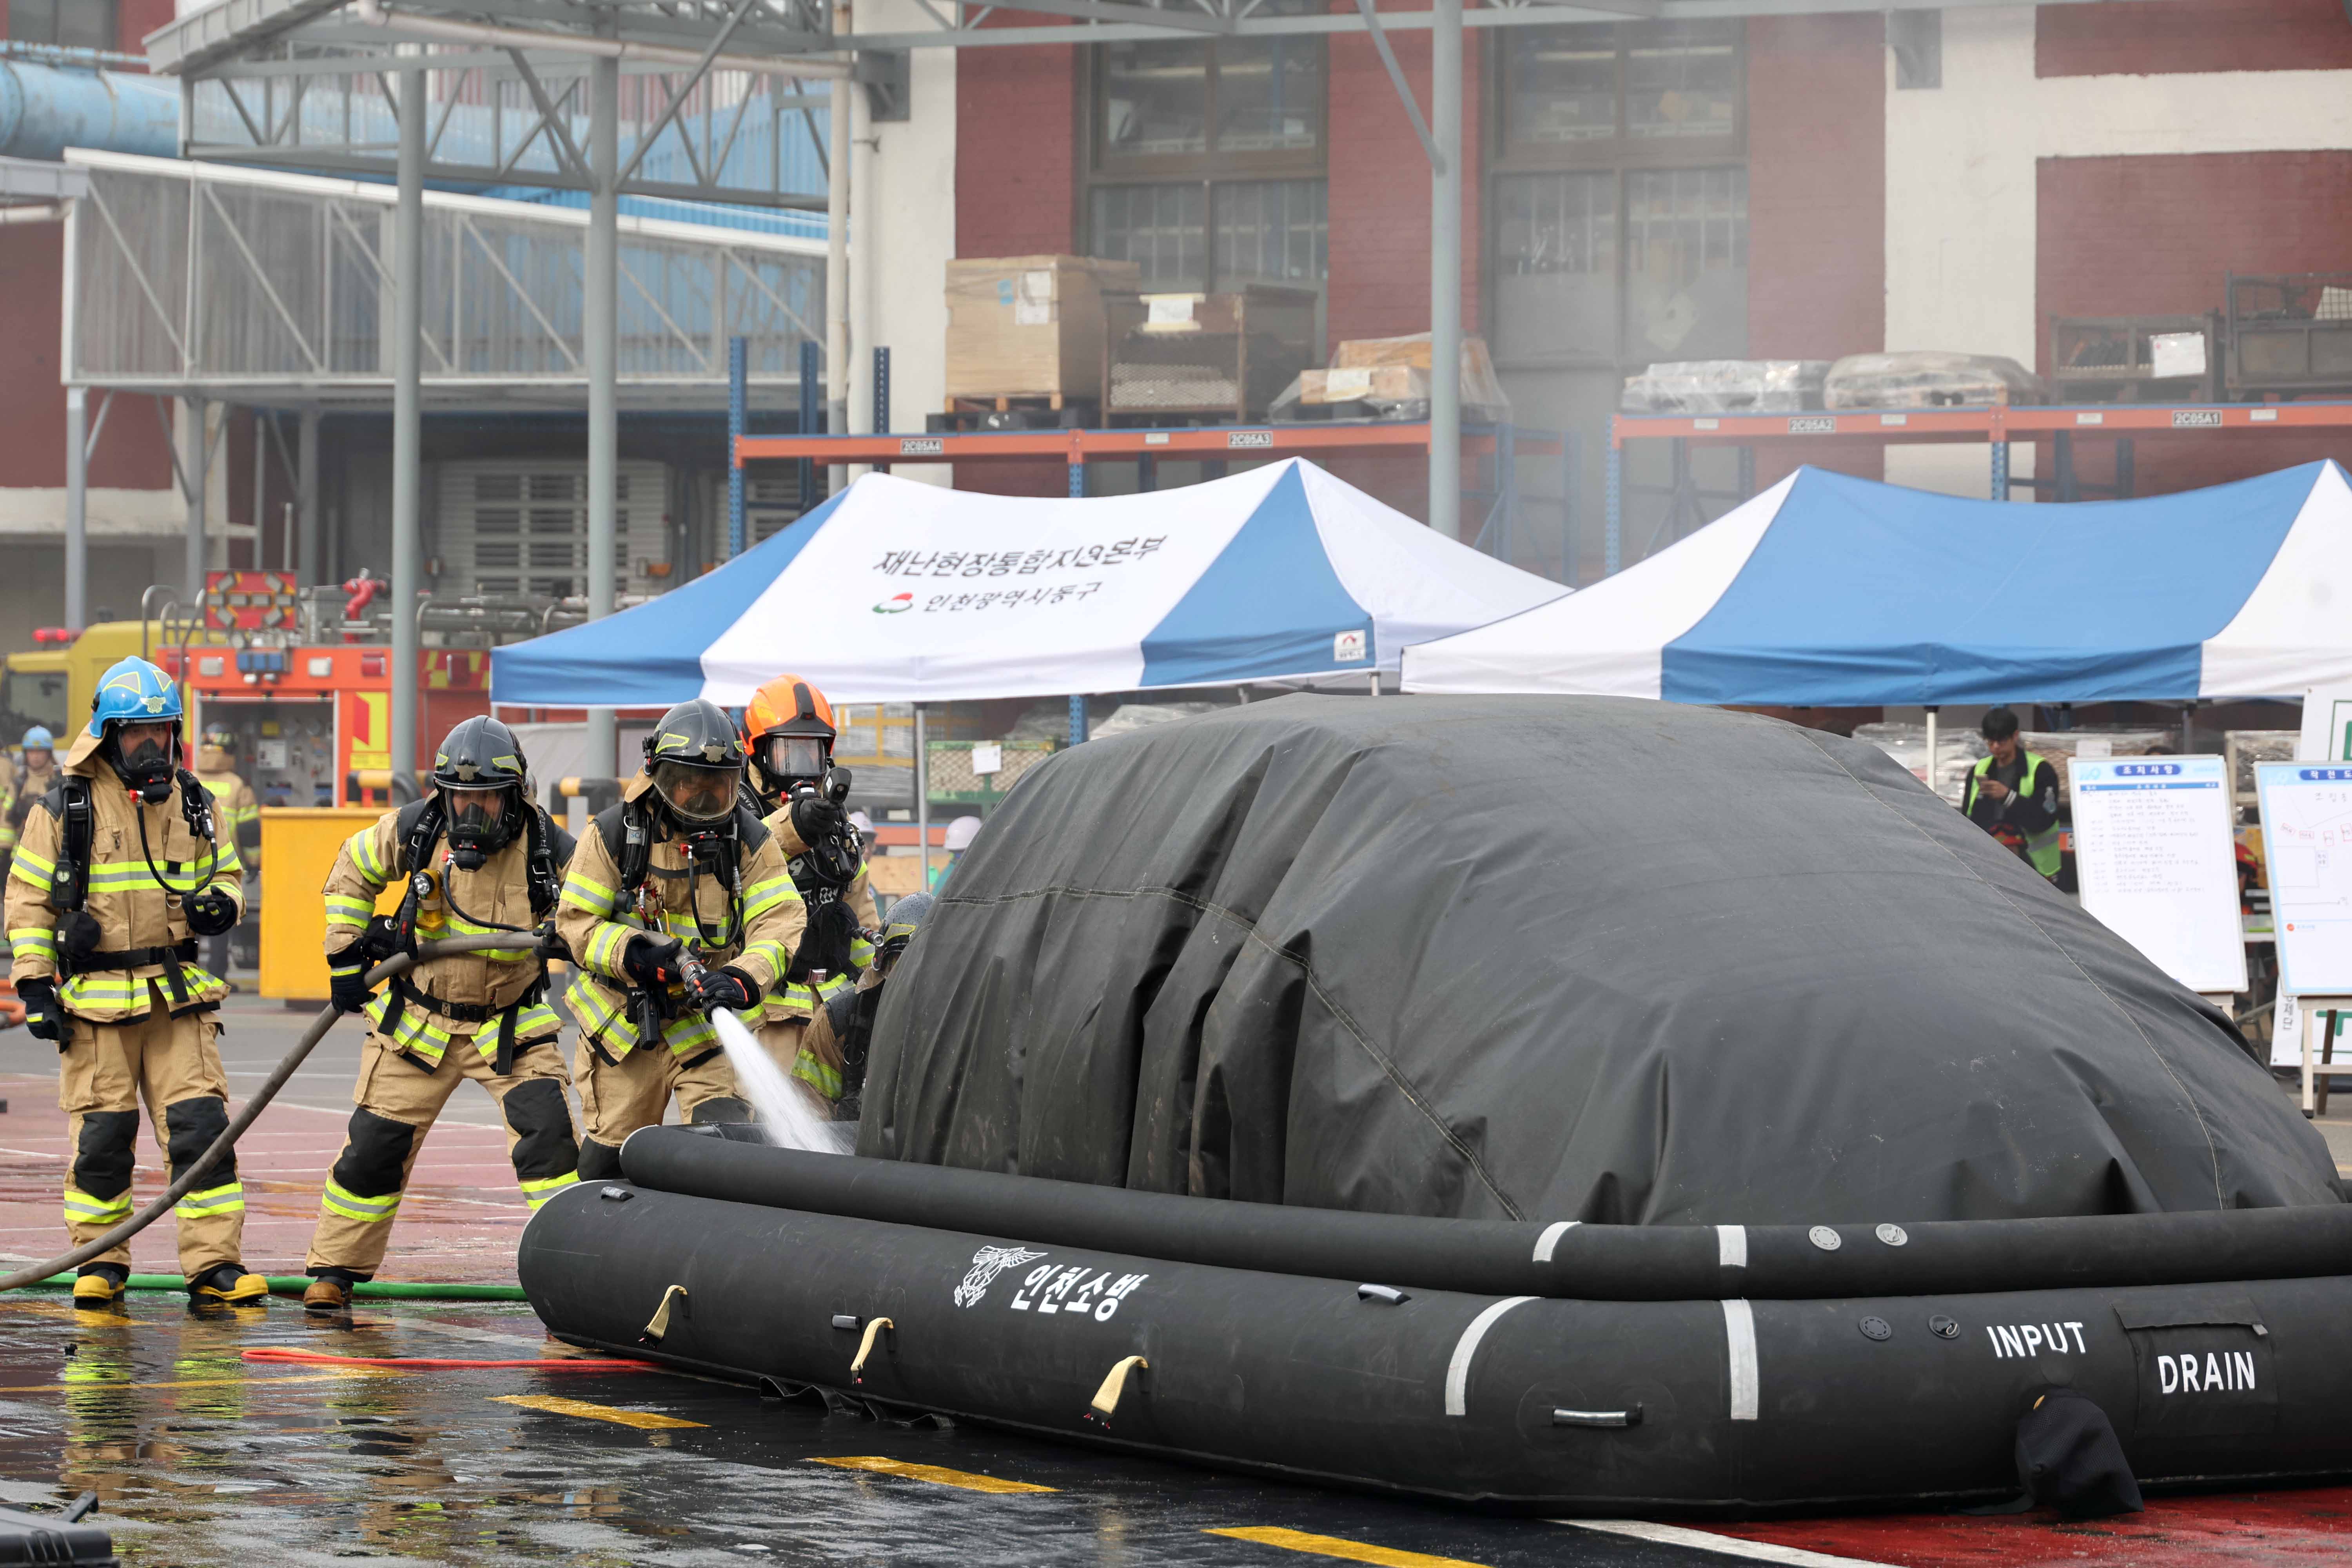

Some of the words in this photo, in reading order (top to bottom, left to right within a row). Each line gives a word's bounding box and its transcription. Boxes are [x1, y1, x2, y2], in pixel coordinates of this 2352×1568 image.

[1010, 1263, 1149, 1321] 인천소방
[1986, 1321, 2086, 1358] INPUT
[2158, 1351, 2256, 1394] DRAIN
